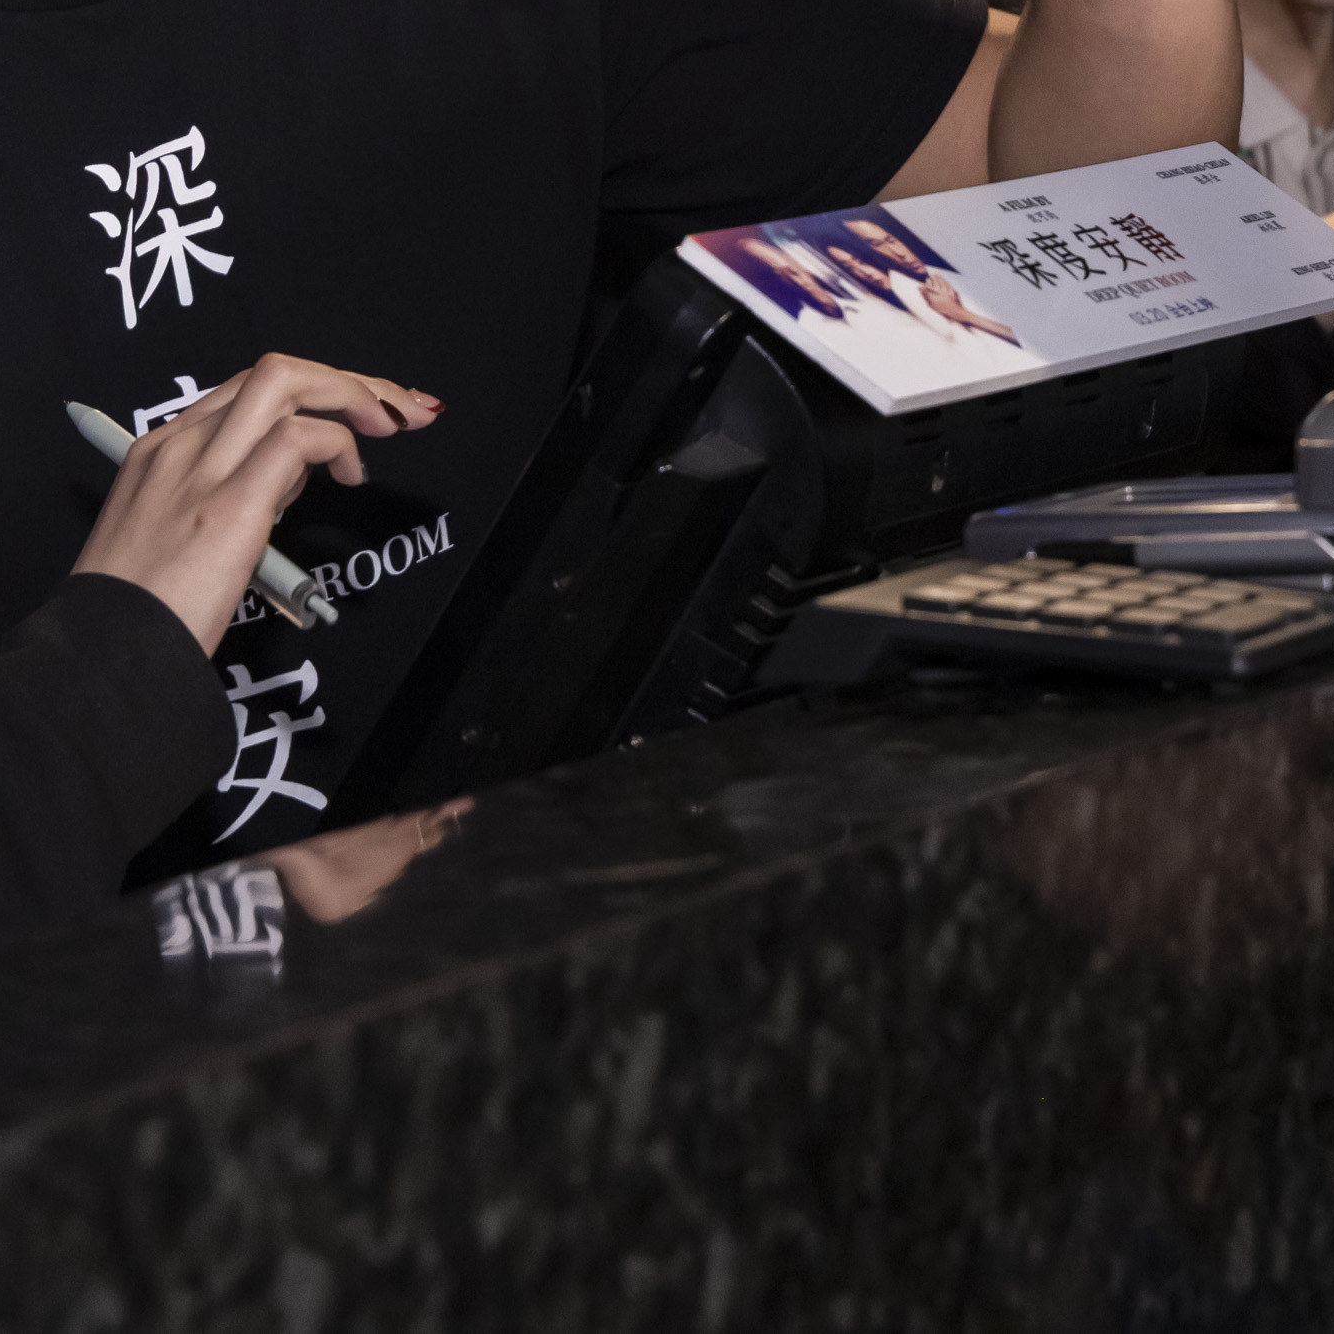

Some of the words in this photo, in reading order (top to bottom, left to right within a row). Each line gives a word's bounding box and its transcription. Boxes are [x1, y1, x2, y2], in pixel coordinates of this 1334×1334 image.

[1005, 198, 1038, 210] FILM
[1032, 196, 1052, 206] BY
[978, 213, 1185, 289] 深度安靜
[1086, 287, 1120, 302] DEEP
[1117, 278, 1160, 298] QUIET
[1153, 271, 1197, 287] ROOM
[83, 125, 328, 845] 深安
[309, 512, 454, 602] ROOM
